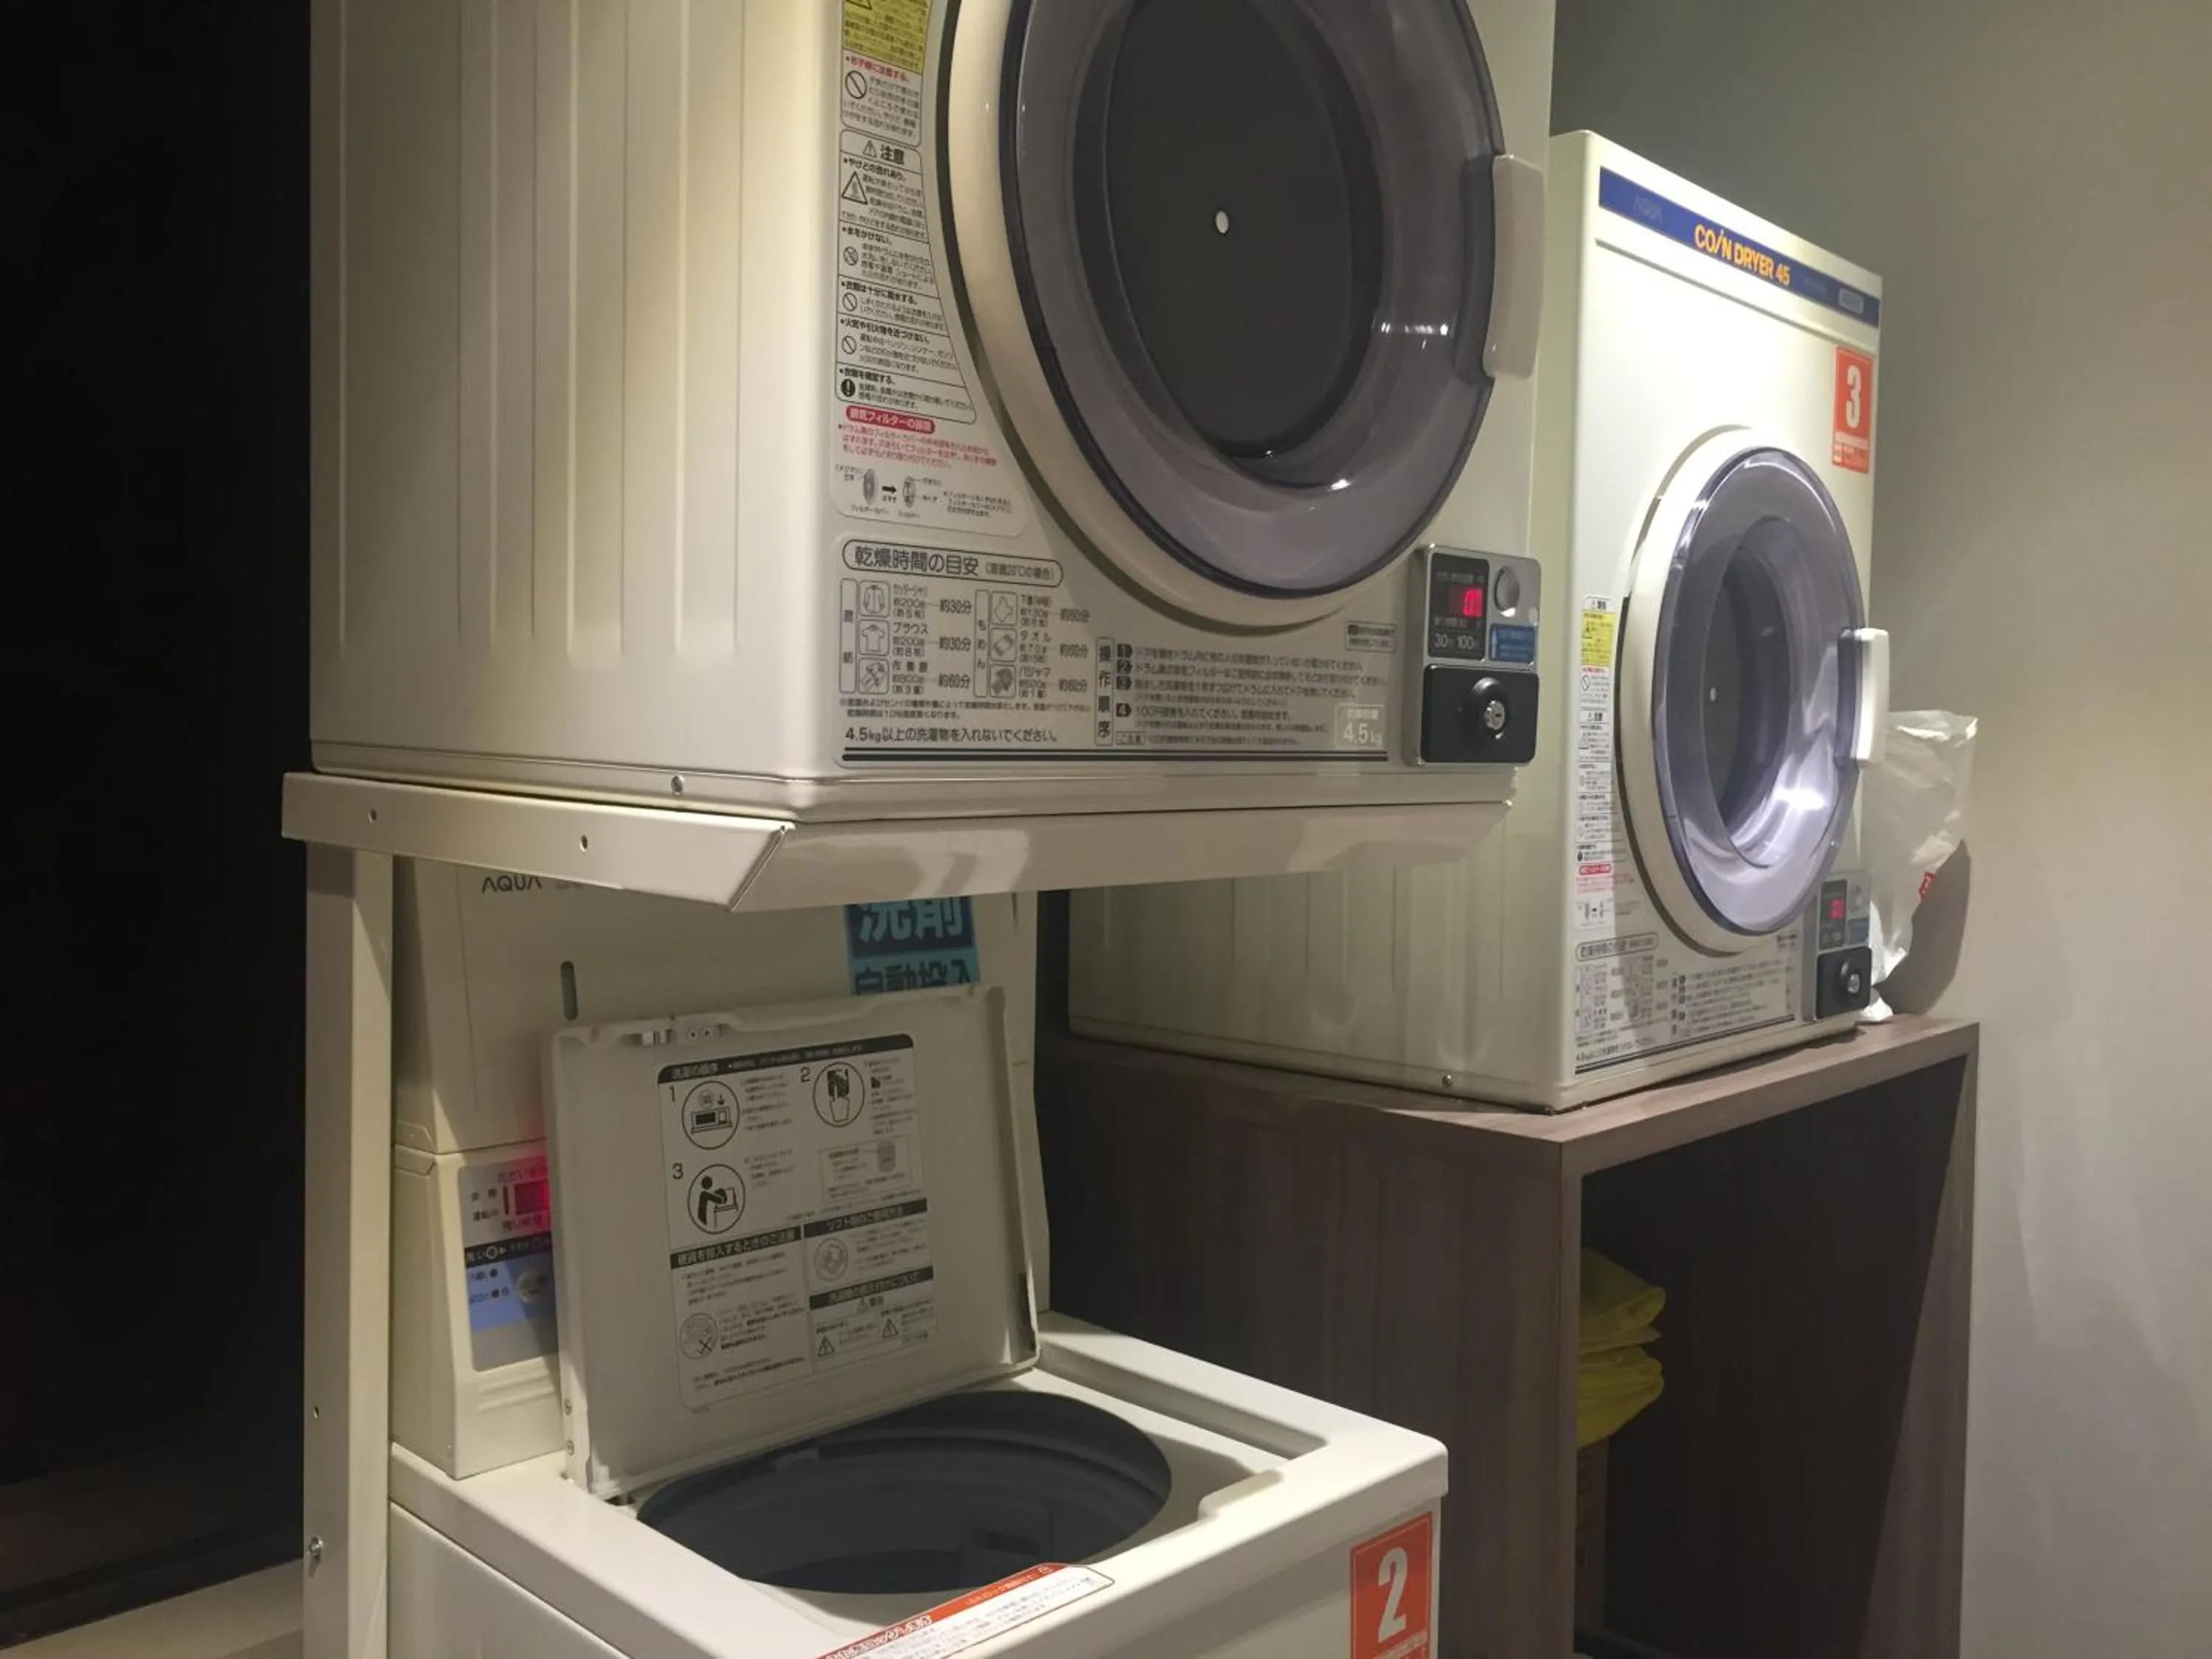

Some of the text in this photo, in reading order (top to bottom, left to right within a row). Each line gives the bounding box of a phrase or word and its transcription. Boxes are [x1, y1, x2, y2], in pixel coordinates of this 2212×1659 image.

[1733, 243, 1774, 279] DRYER
[1775, 262, 1790, 286] 45
[1846, 365, 1862, 429] 3
[855, 546, 978, 577] 乾燥時間の目安
[481, 875, 543, 894] AQUA
[855, 959, 971, 995] 自動投入
[800, 1067, 811, 1082] 2
[669, 1086, 676, 1102] 1
[672, 1163, 684, 1180] 3
[1378, 1547, 1408, 1644] 2
